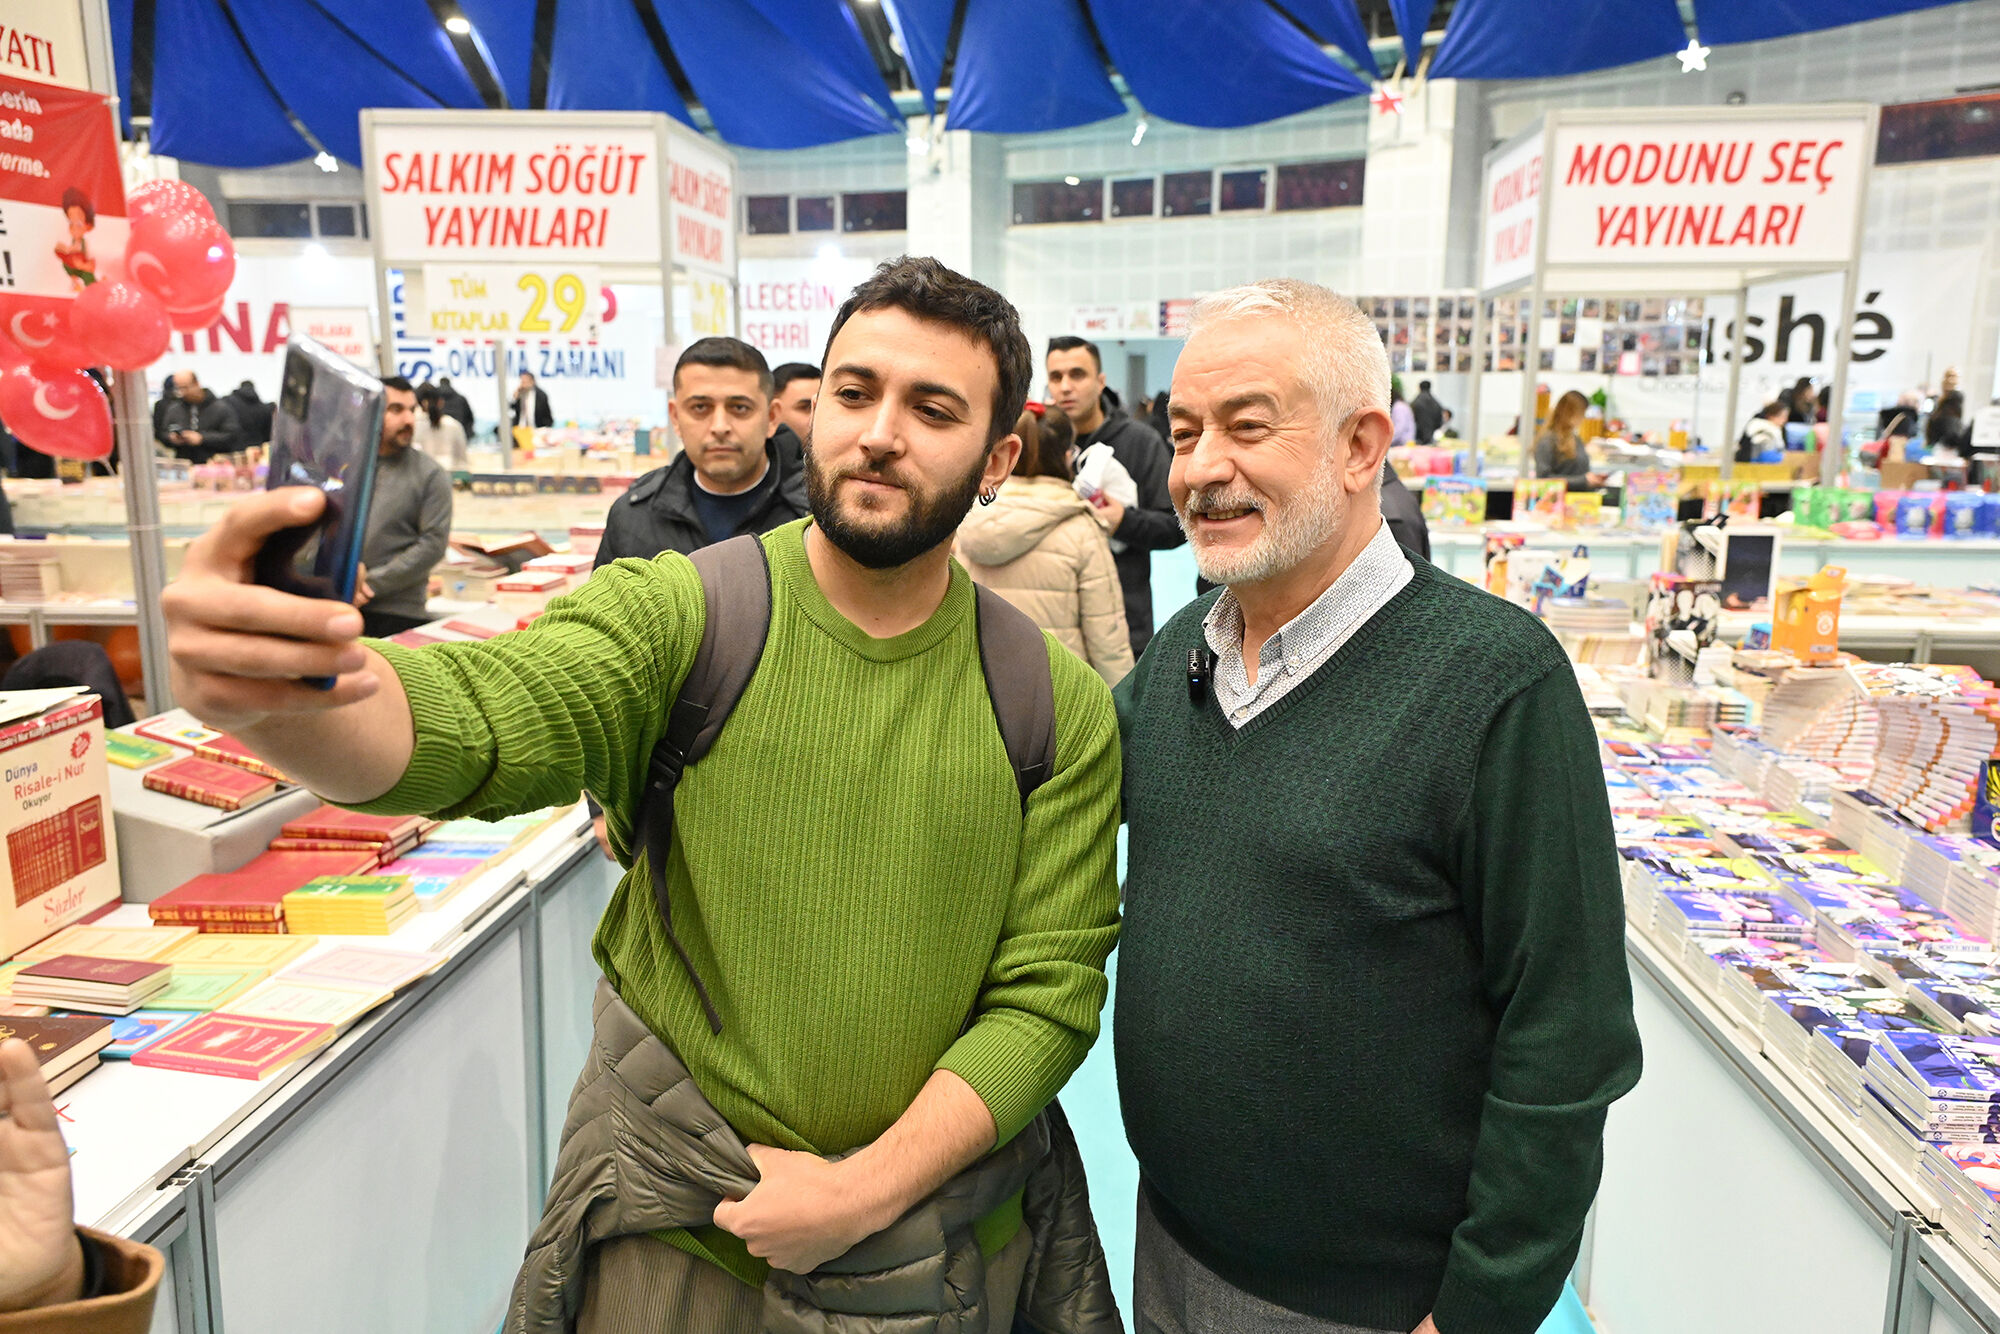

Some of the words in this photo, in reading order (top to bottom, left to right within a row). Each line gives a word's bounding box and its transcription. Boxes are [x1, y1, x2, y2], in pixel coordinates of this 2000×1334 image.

[0, 25, 57, 77] ATI
[0, 90, 43, 115] erin
[0, 118, 34, 143] ada
[381, 153, 515, 193] SALKIM
[525, 145, 646, 195] SÖĞÜT
[1565, 141, 1754, 186] MODUNU
[1761, 140, 1844, 194] SEÇ
[425, 206, 608, 247] YAYINLARI
[1596, 203, 1804, 246] YAYINLARI
[449, 272, 488, 298] TÜM
[517, 274, 586, 332] 29
[738, 279, 835, 310] LECEĞİN
[432, 307, 509, 331] KİTAPLAR
[449, 349, 529, 377] OKUA
[541, 349, 625, 377] ZAMANI
[5, 762, 38, 783] Dünya
[14, 769, 62, 801] Risale-i
[64, 762, 86, 780] Nur
[22, 792, 52, 811] Okuyor
